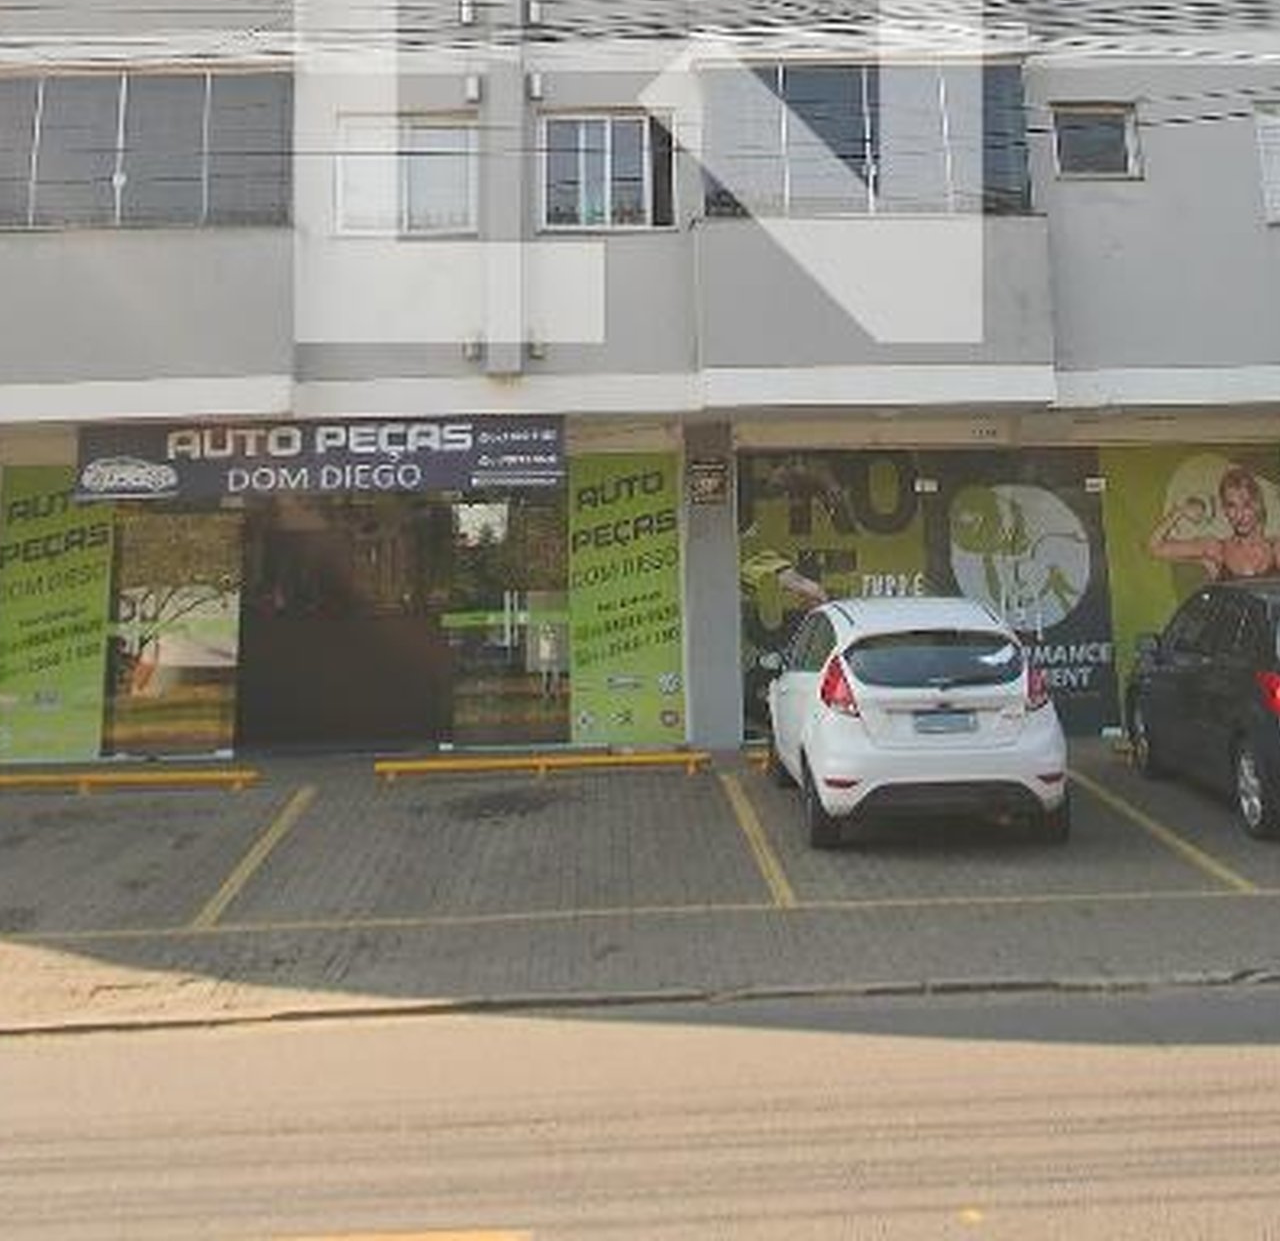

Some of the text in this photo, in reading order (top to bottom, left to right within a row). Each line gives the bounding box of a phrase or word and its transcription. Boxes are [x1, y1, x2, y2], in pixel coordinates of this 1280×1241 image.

[166, 426, 302, 460] AUTO
[315, 422, 473, 462] PEÇAS
[227, 463, 422, 493] DOM DIEGO
[577, 470, 664, 512] AUTO
[7, 489, 72, 526] AUT
[572, 508, 678, 554] PEÇAS
